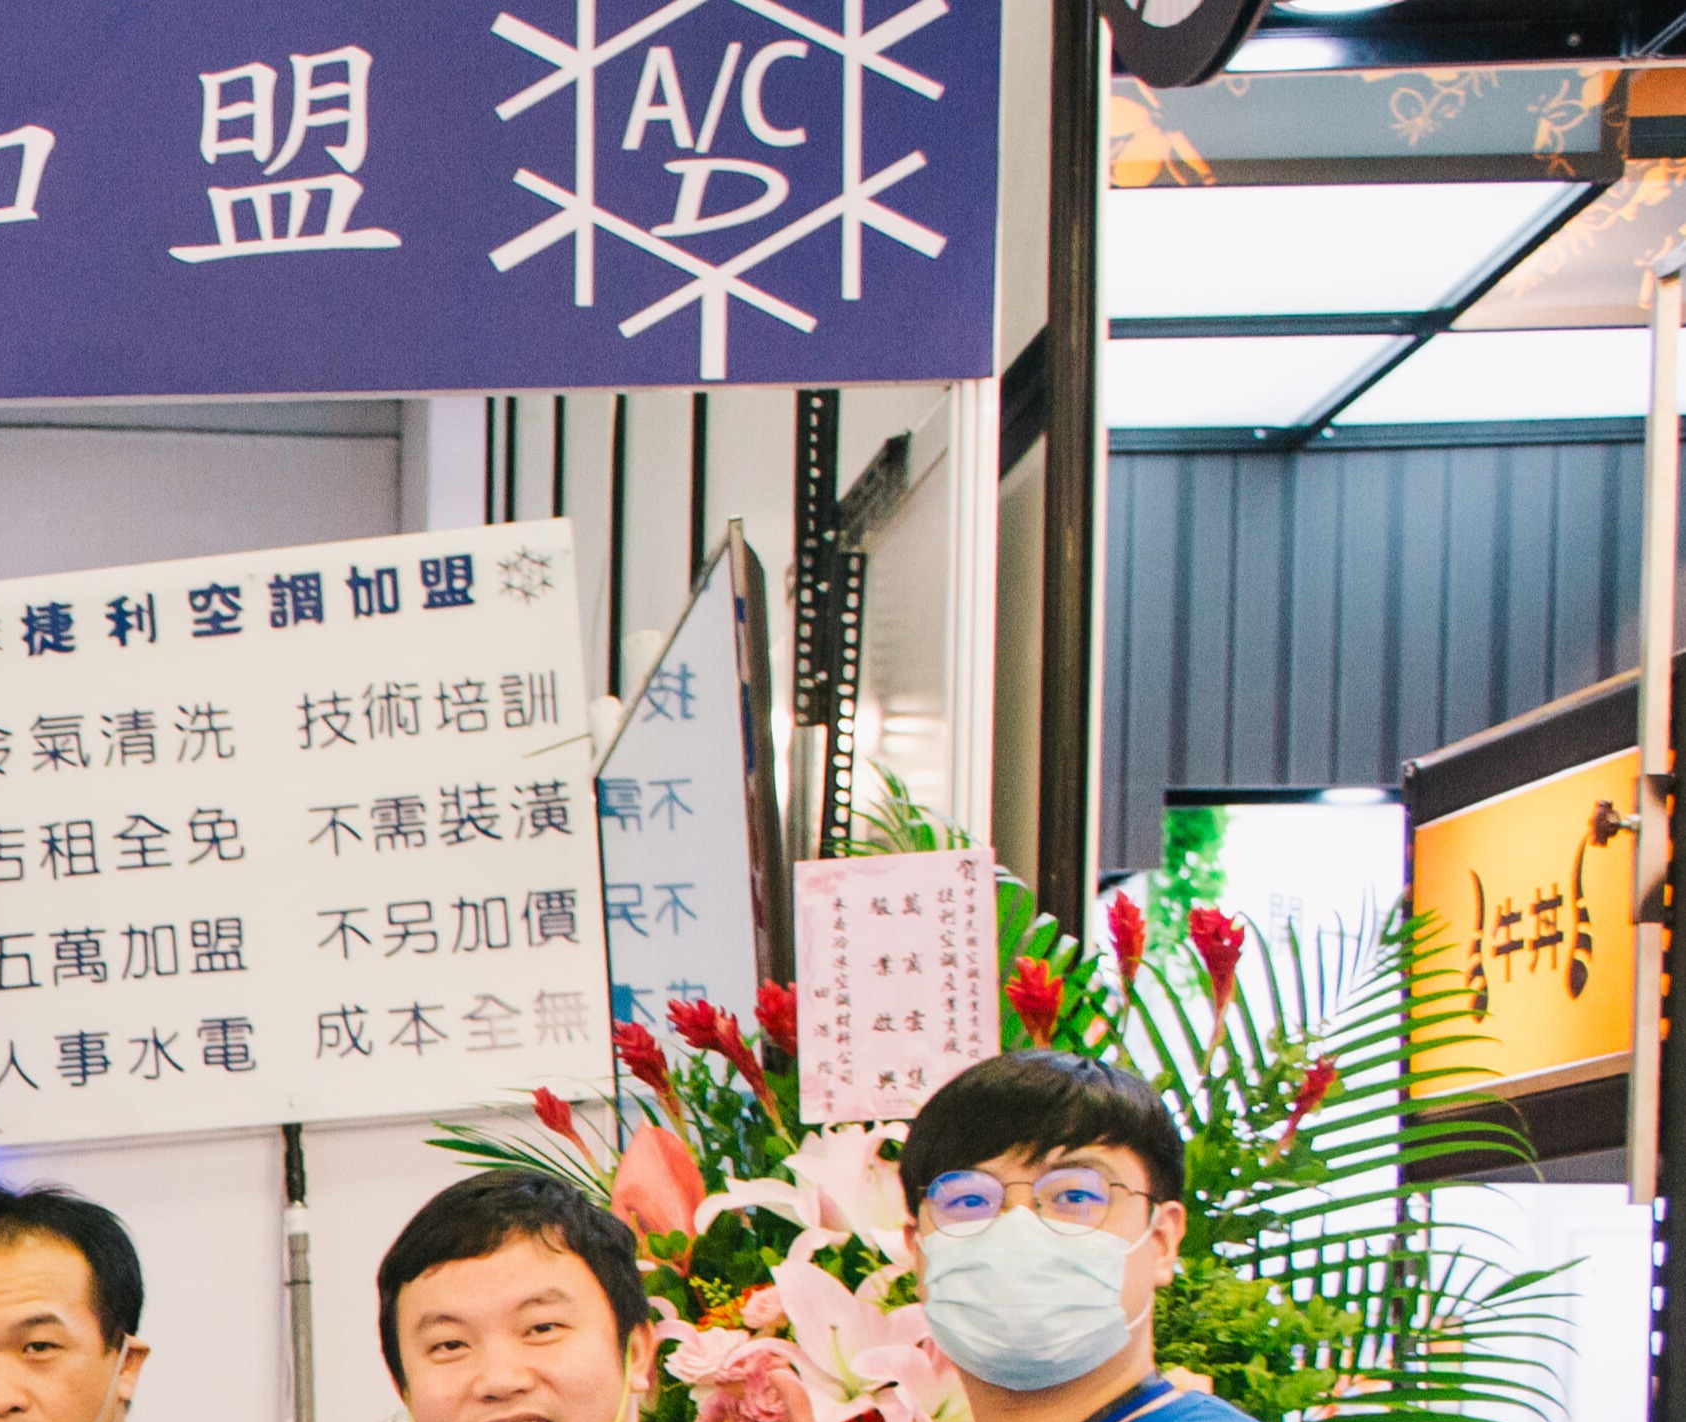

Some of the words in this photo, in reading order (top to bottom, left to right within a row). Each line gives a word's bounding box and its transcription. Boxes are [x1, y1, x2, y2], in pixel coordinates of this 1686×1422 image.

[619, 39, 811, 155] A/C
[647, 156, 793, 239] D
[20, 552, 478, 658] 捷利空調加盟
[295, 667, 563, 752] 技術培訓
[306, 777, 575, 859] 不需裝潢
[316, 887, 583, 963] 不另加價
[1490, 881, 1565, 984] 牛丼
[314, 987, 592, 1064] 成本全無
